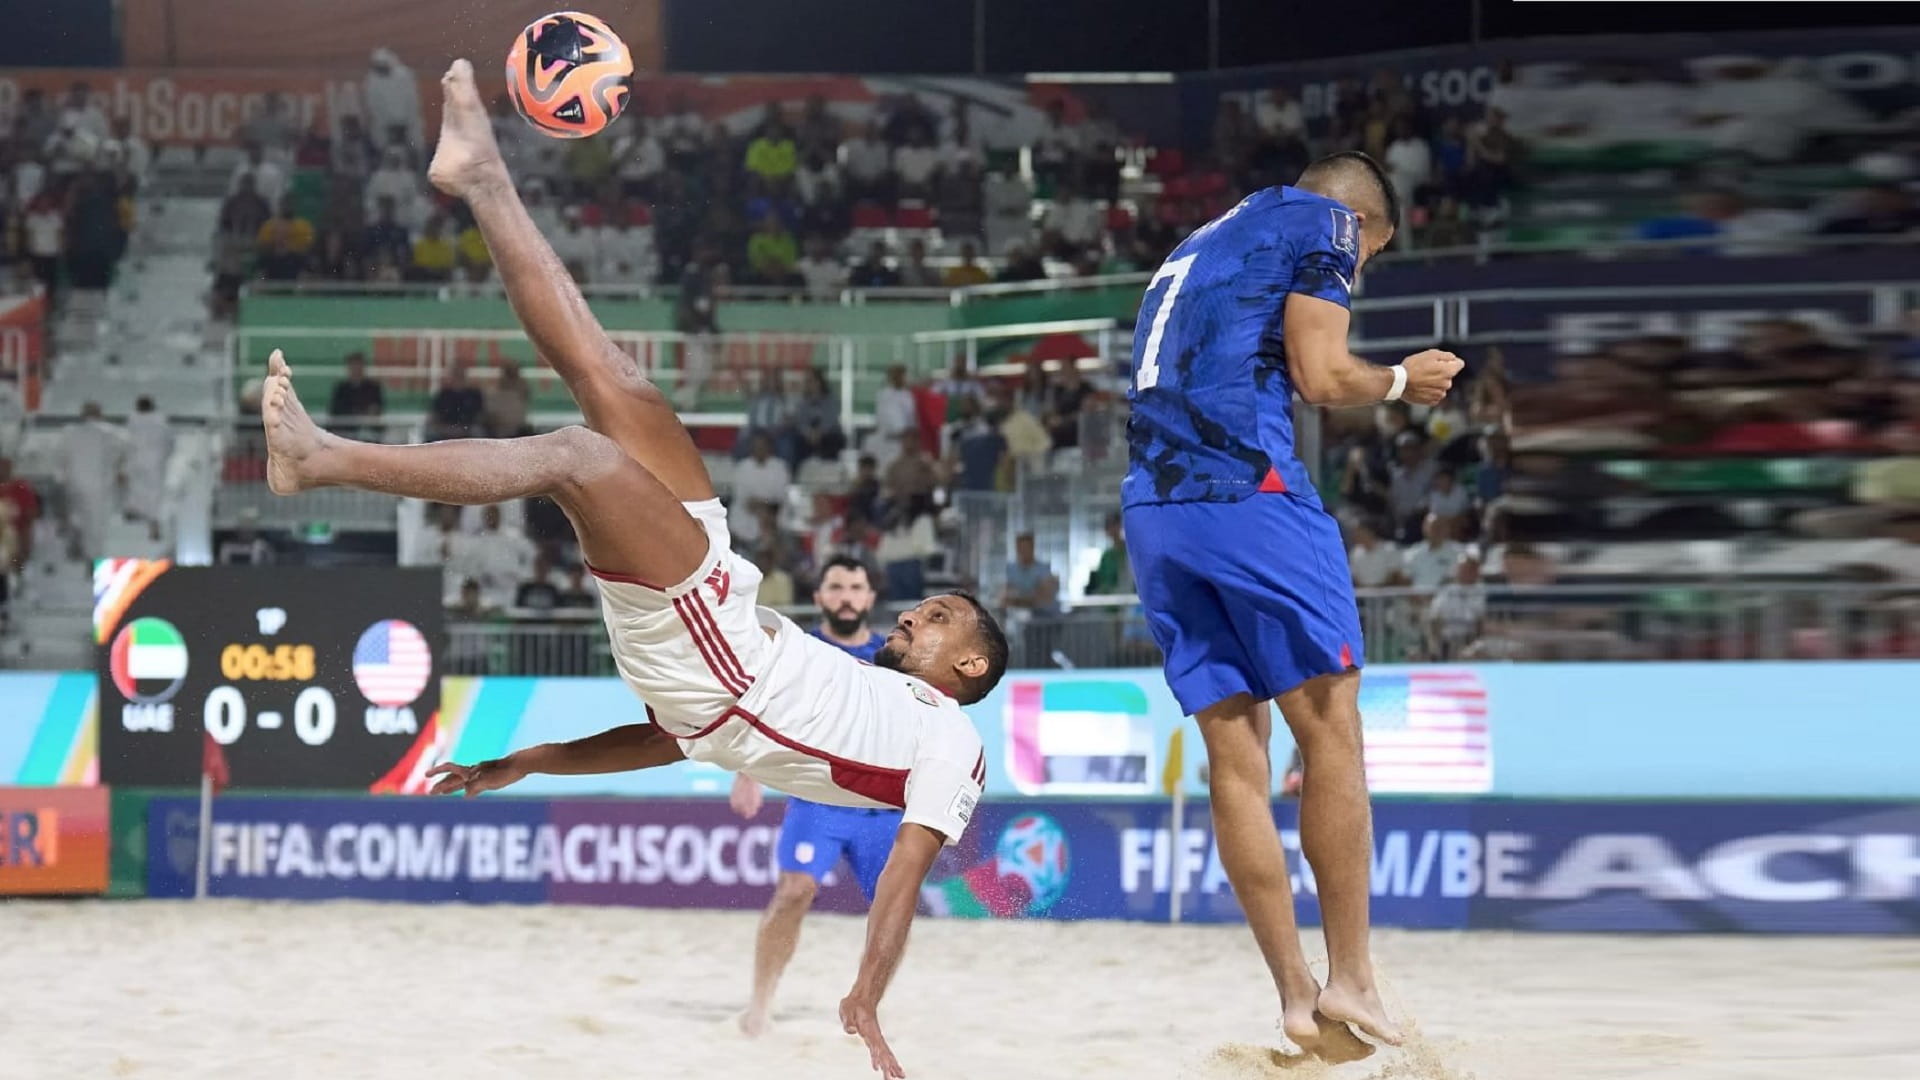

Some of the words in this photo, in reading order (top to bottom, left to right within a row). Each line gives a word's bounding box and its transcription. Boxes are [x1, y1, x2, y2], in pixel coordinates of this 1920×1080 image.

[1136, 253, 1198, 392] 7
[221, 643, 315, 681] 00:58
[122, 703, 174, 732] UAE
[203, 686, 247, 744] 0
[294, 687, 336, 745] 0
[364, 706, 418, 734] USA
[211, 823, 838, 886] FIFA.COM/BEACHSOCC
